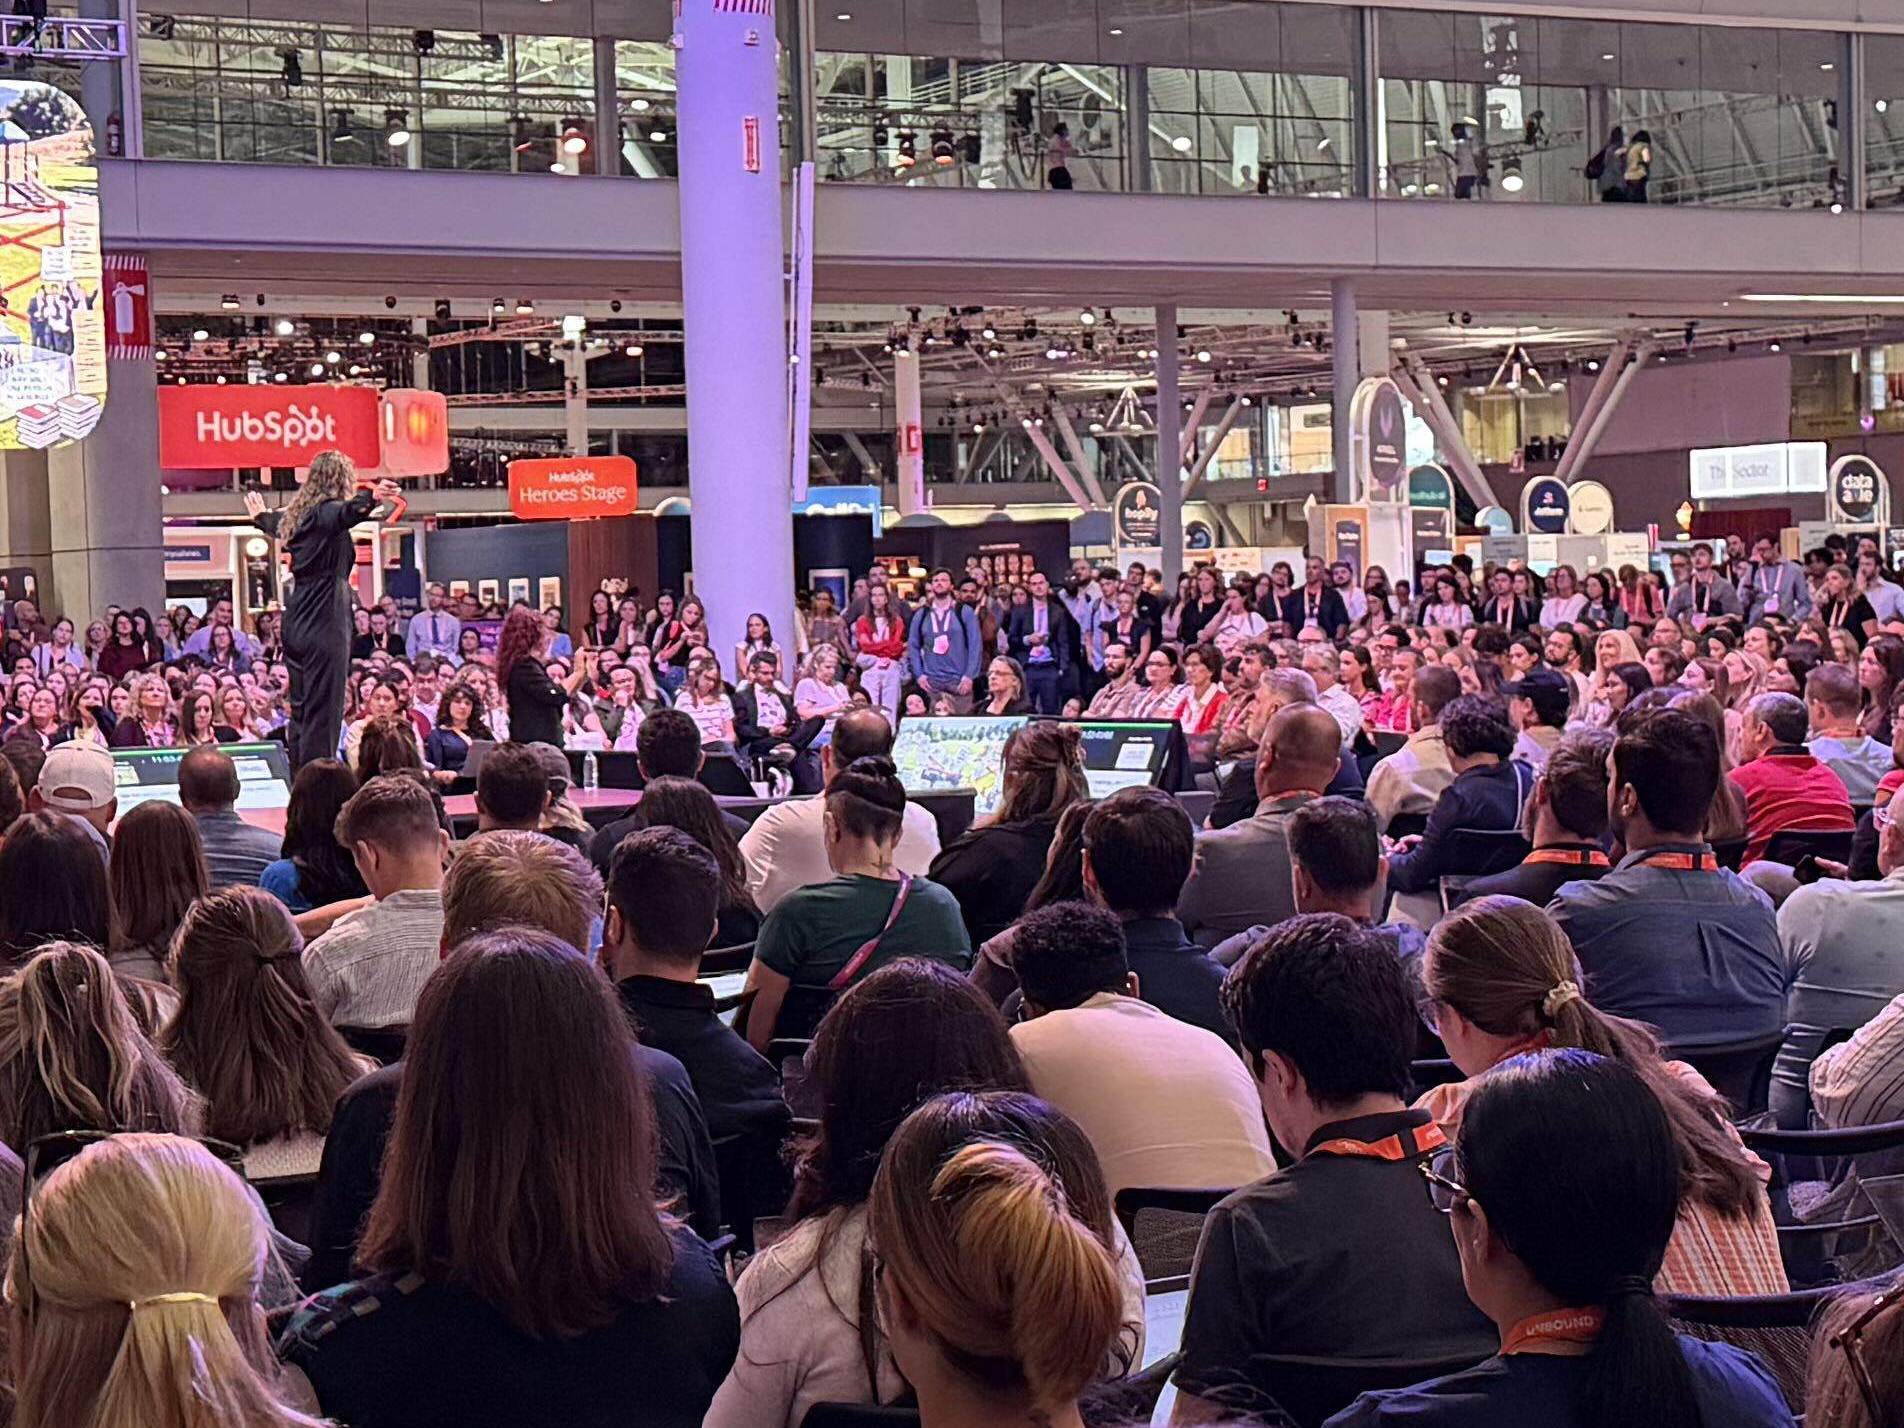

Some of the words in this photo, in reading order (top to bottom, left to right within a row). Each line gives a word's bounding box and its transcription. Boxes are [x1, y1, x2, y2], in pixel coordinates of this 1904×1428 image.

[196, 404, 336, 448] HubSpot
[548, 468, 595, 485] HubSpot
[1842, 474, 1874, 489] data
[519, 485, 579, 502] Heroes
[581, 484, 627, 505] Stage
[1526, 1315, 1594, 1336] UNBOUND
